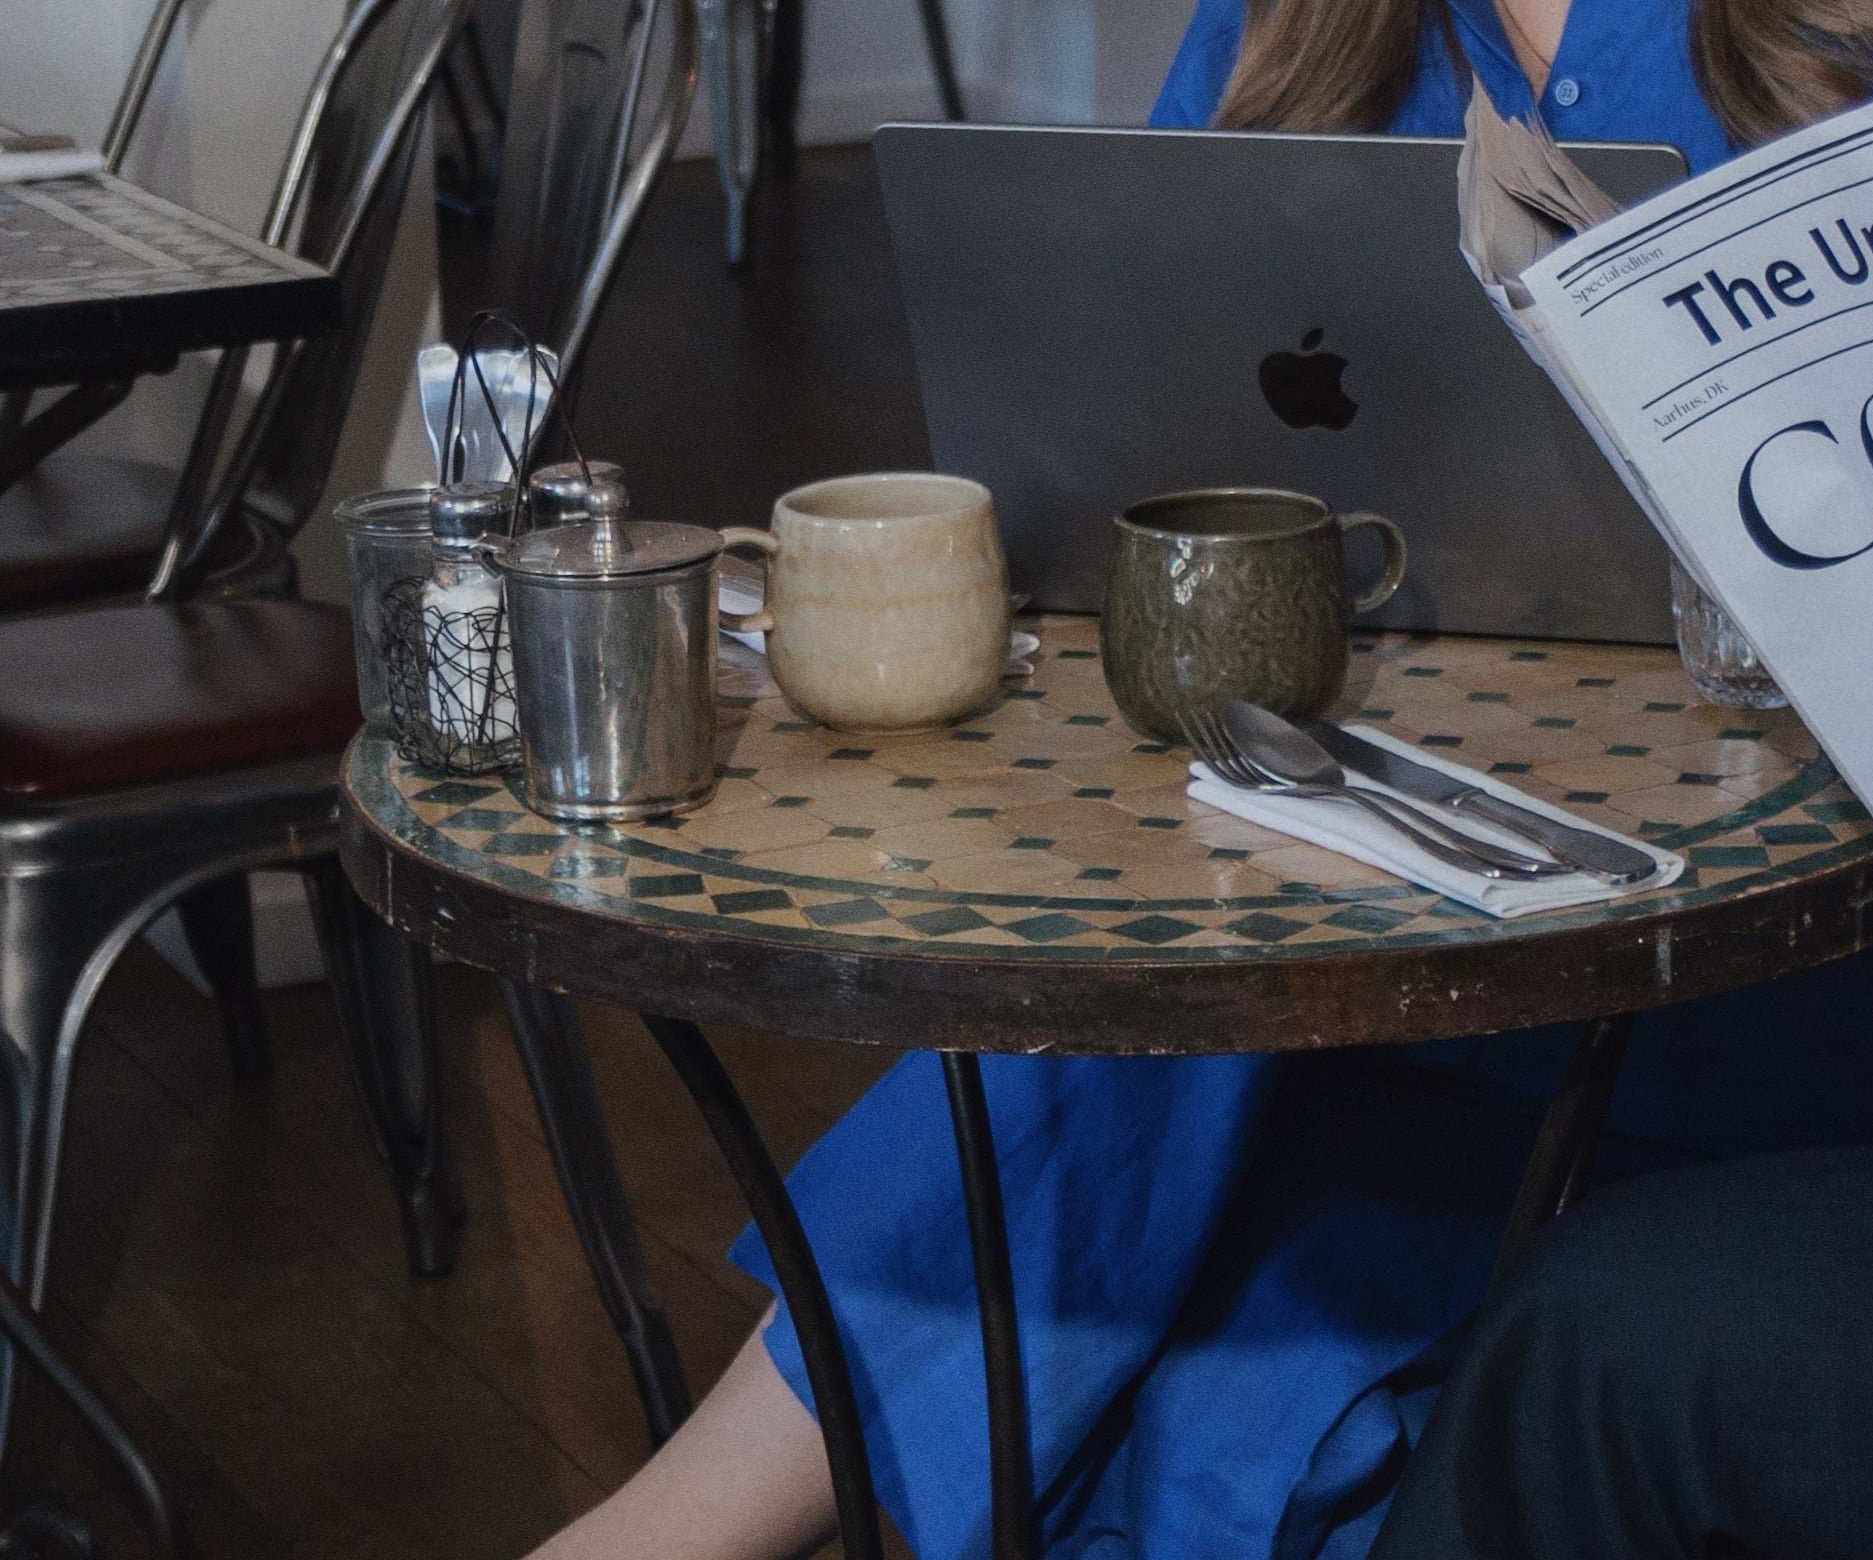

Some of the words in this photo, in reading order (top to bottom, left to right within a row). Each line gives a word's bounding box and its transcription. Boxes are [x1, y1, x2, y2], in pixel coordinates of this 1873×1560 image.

[1571, 266, 1621, 304] Special
[1621, 248, 1665, 274] edition
[1662, 255, 1815, 346] The
[1653, 396, 1706, 432] Aarhus,
[1704, 380, 1729, 399] DK
